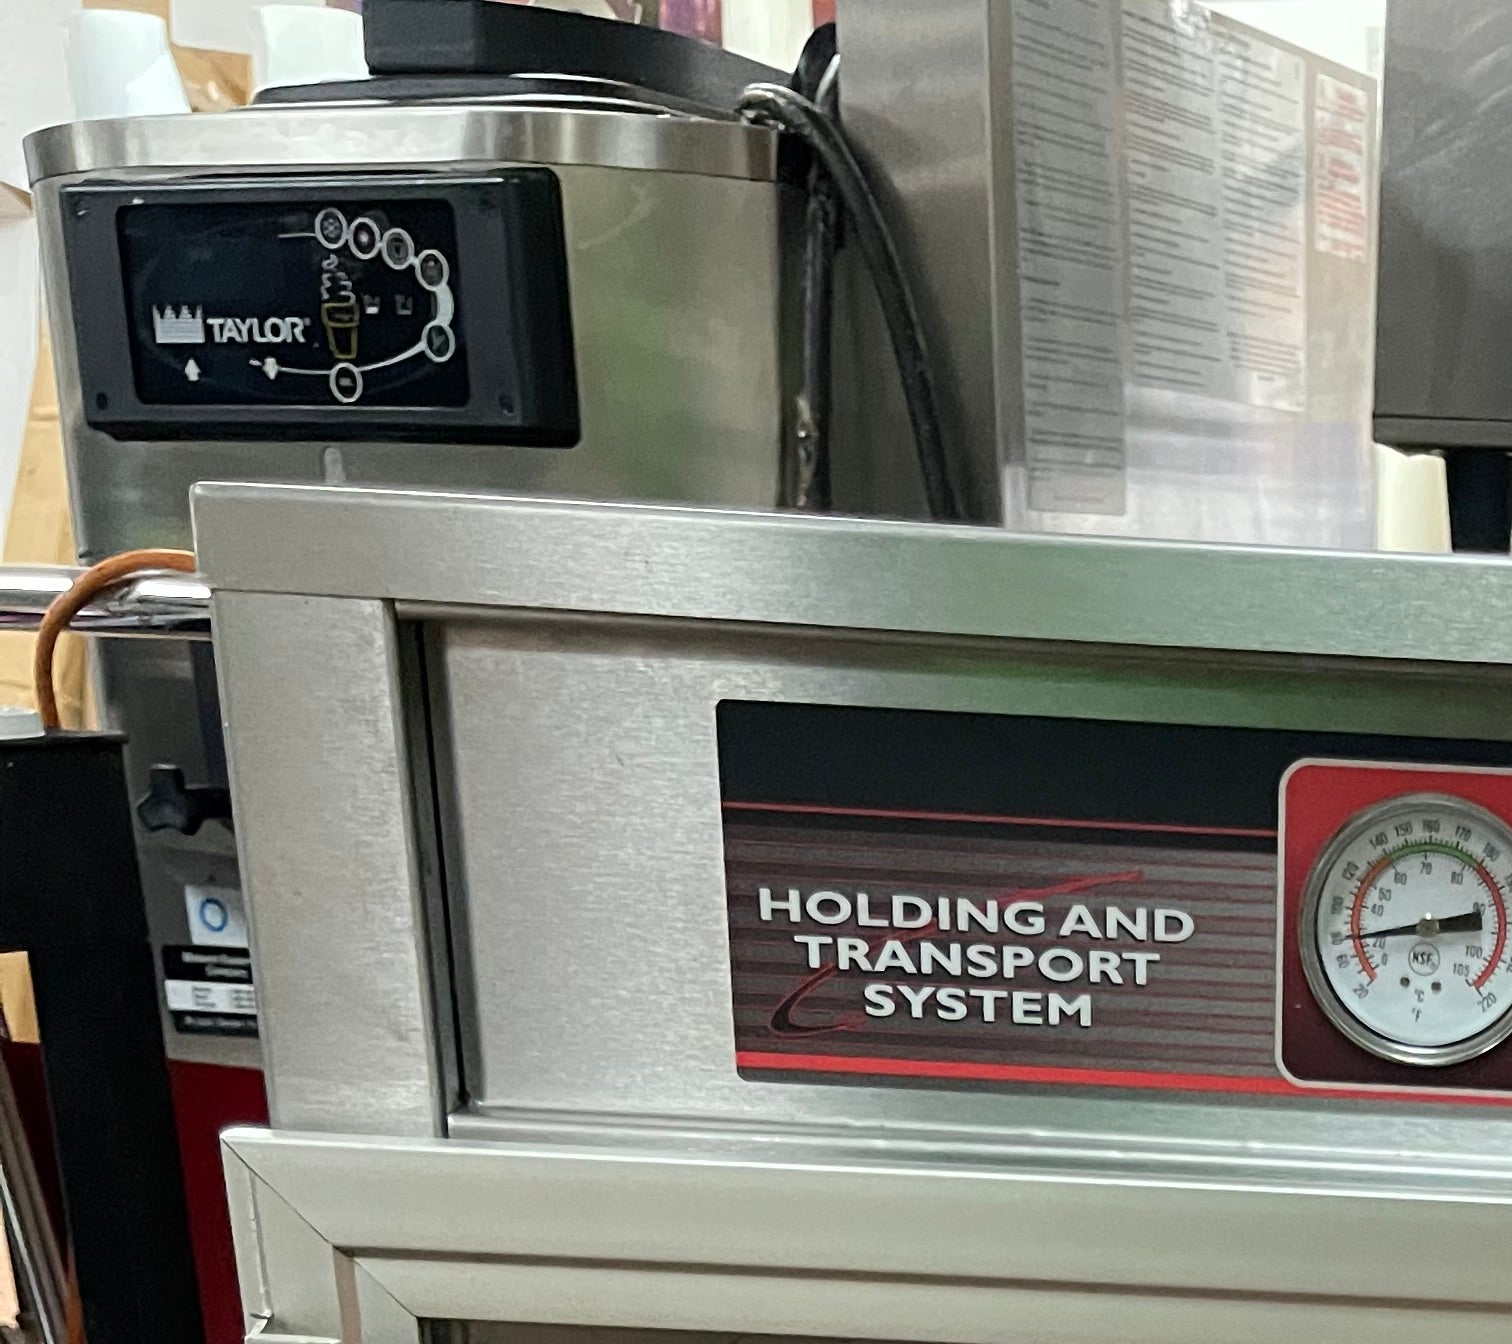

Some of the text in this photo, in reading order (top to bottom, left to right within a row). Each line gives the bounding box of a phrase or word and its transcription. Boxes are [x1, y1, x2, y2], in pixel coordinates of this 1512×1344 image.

[206, 317, 306, 343] TAYLOR
[1420, 861, 1432, 875] 70
[759, 887, 1195, 942] HOLDING AND
[1371, 903, 1384, 917] 40
[1394, 821, 1413, 837] 150
[1455, 825, 1472, 842] 170
[1477, 992, 1497, 1013] 220
[793, 935, 1161, 986] TRANSPORT
[1411, 951, 1435, 965] NSF
[1465, 945, 1483, 959] 100
[1452, 963, 1470, 977] 105
[864, 984, 1092, 1027] SYSTEM
